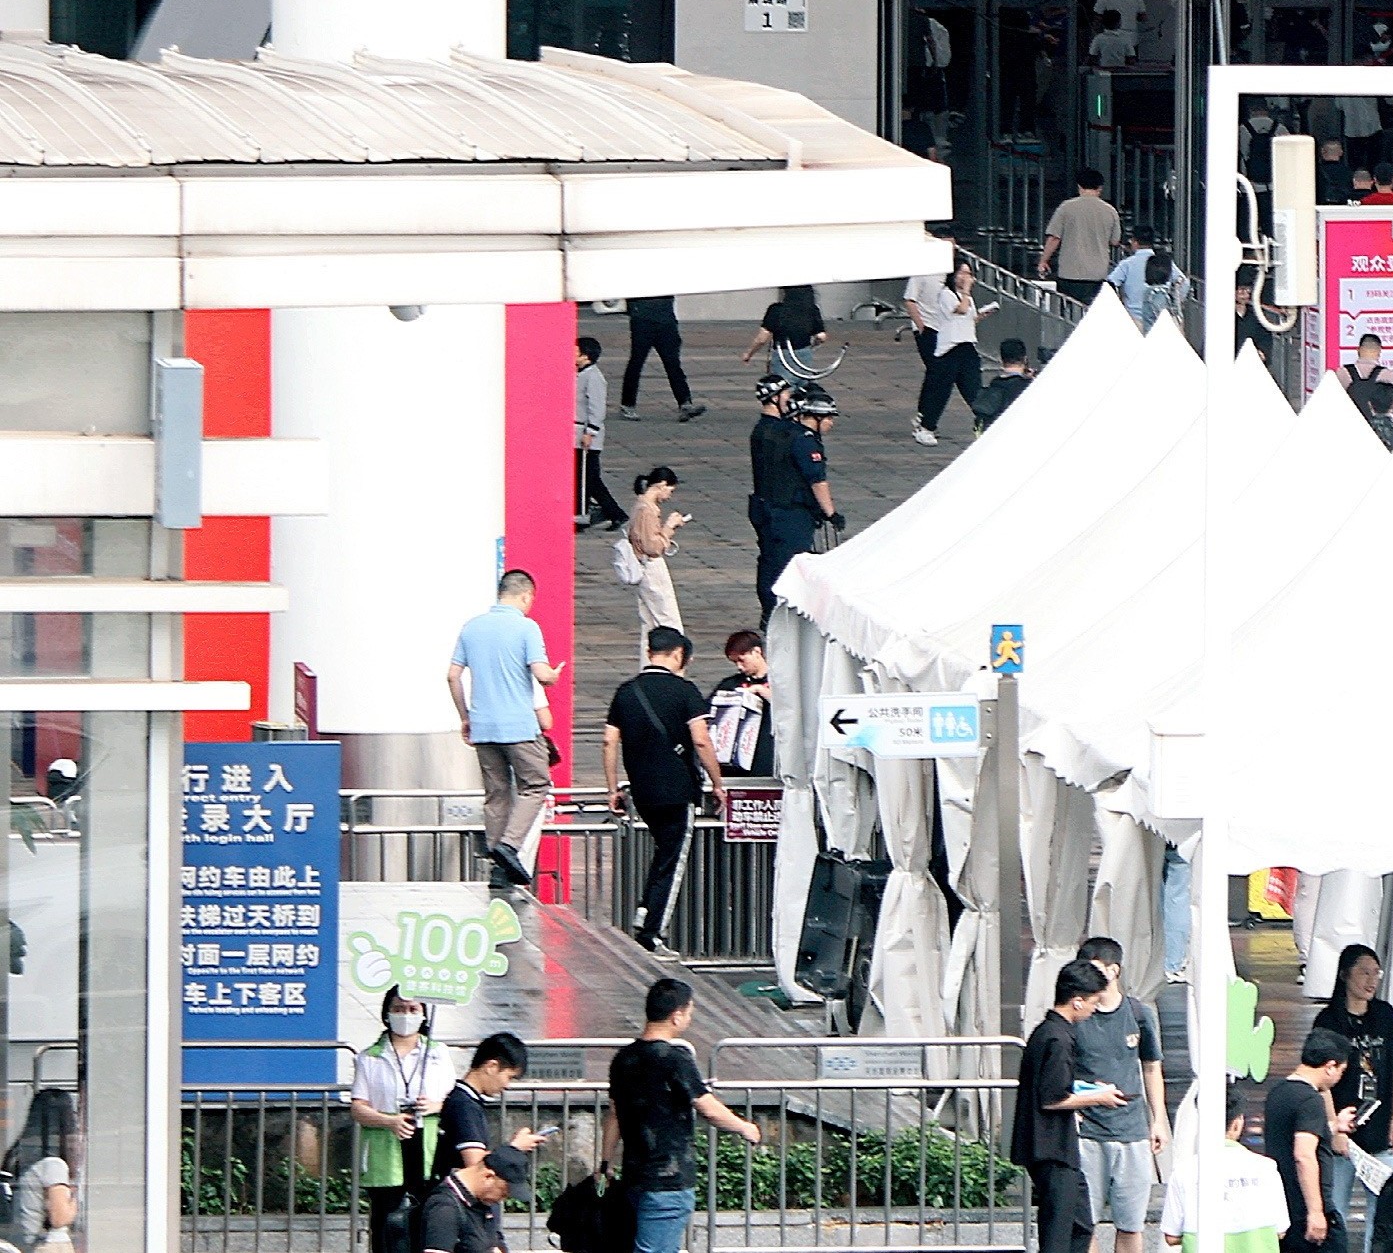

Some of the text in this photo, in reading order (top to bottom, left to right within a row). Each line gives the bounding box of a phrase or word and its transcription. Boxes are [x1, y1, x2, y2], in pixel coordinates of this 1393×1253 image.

[762, 12, 772, 28] 1
[402, 916, 489, 967] 100
[184, 982, 307, 1006] 车上下客区
